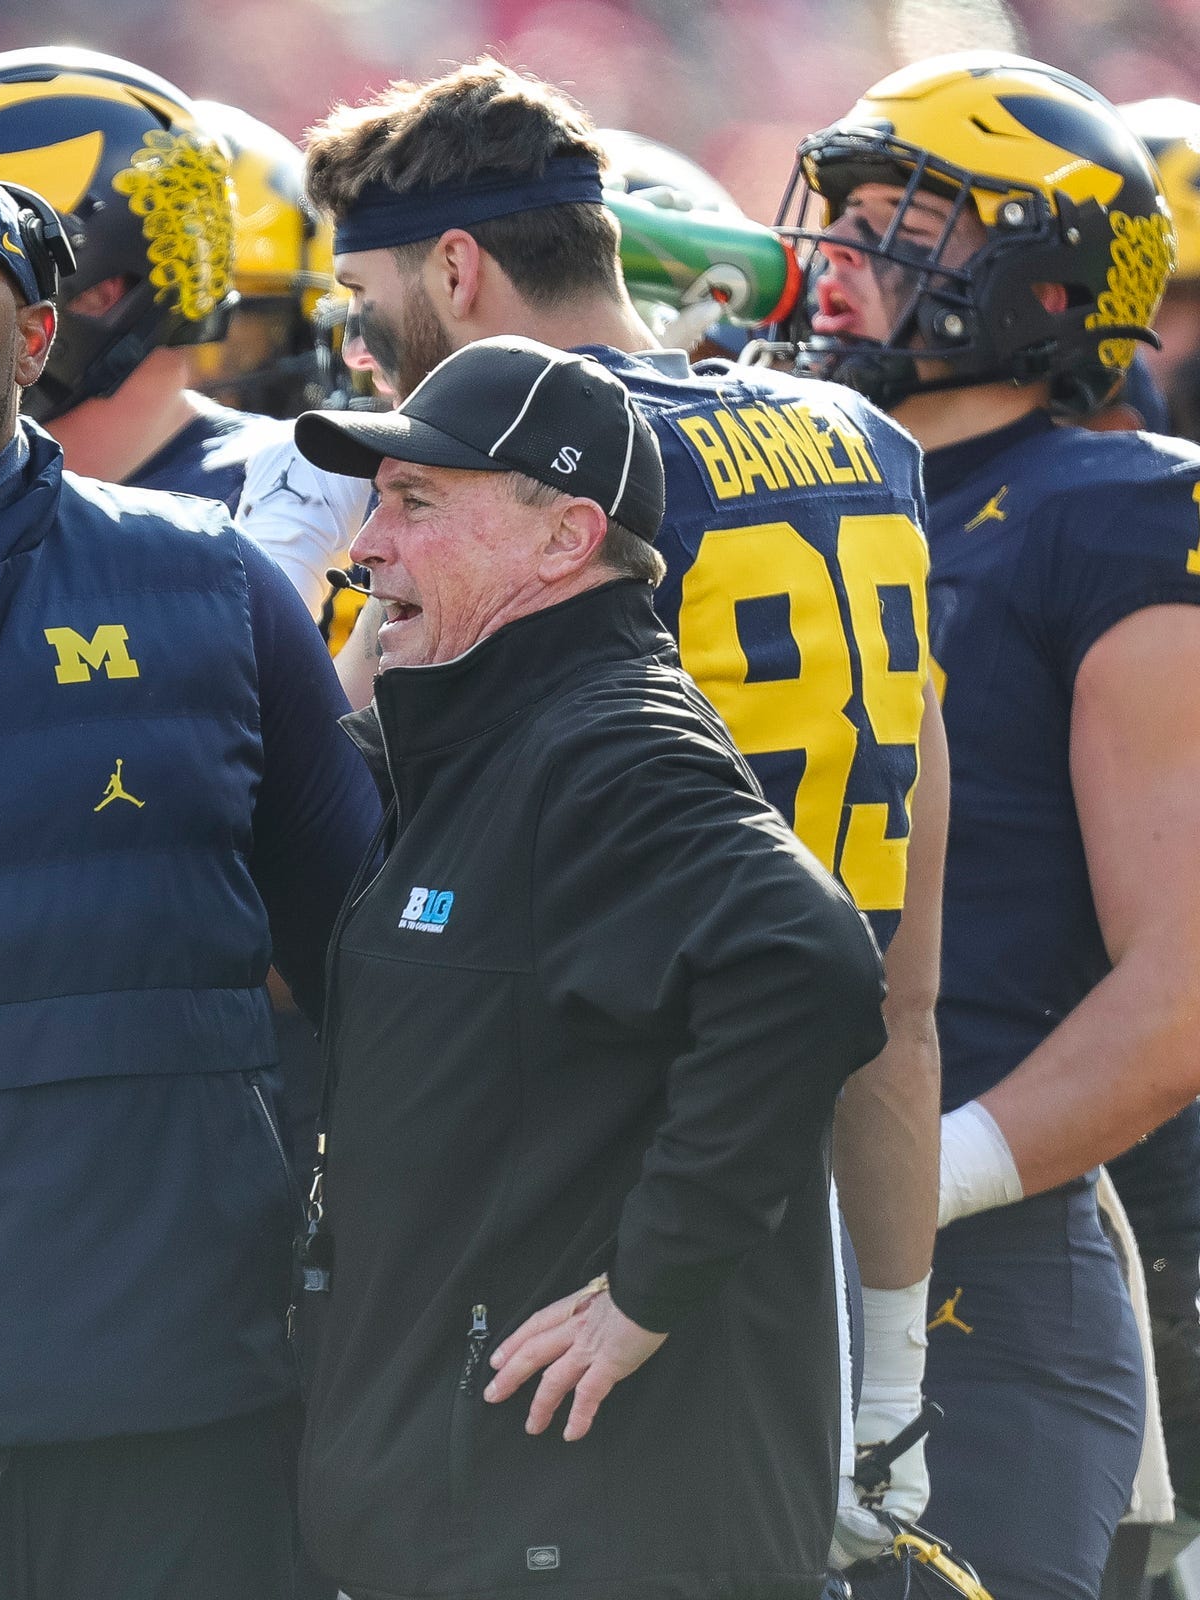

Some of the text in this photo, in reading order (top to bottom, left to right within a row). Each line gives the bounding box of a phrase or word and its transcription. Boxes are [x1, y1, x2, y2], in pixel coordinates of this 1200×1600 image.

[677, 400, 882, 500] BARNER
[44, 624, 139, 685] M
[678, 513, 930, 912] 89
